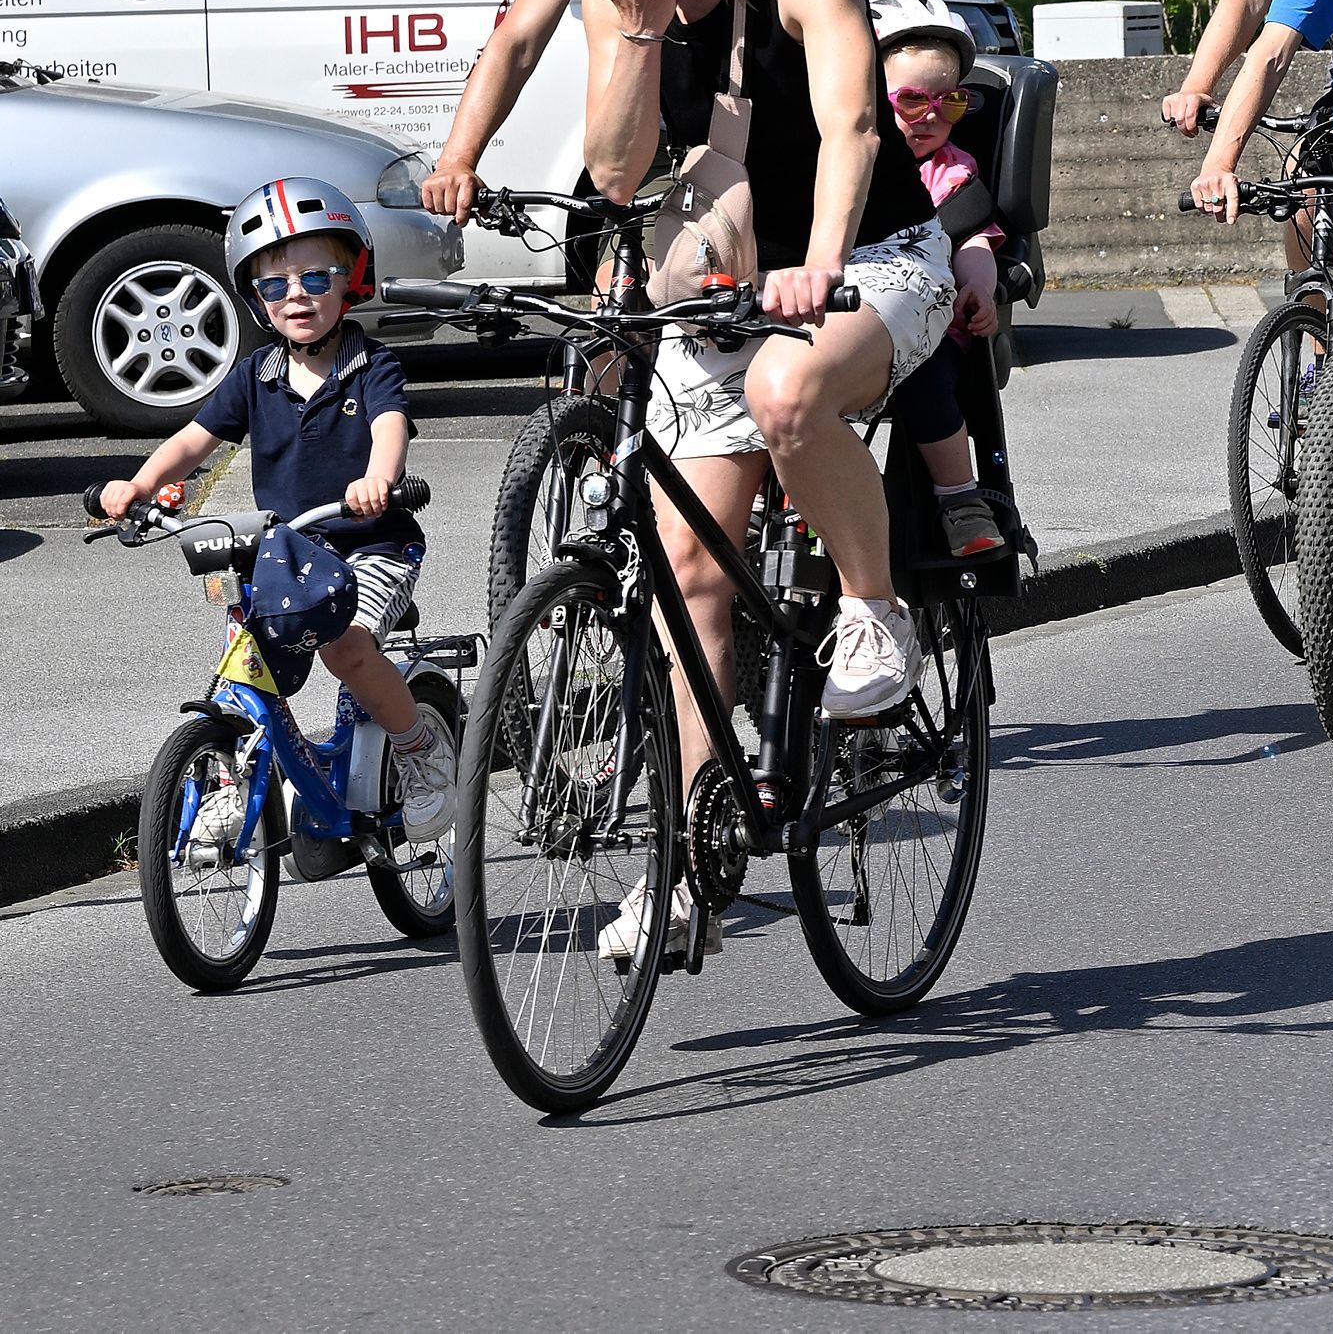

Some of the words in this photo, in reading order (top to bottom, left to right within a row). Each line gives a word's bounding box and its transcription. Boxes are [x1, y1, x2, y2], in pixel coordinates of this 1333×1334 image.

[344, 13, 448, 54] IHB
[324, 59, 470, 77] Maler-Fachbetrieb
[373, 106, 405, 116] 22-24,
[408, 105, 439, 115] 50321
[326, 212, 353, 223] uvex
[193, 533, 256, 554] PUKY
